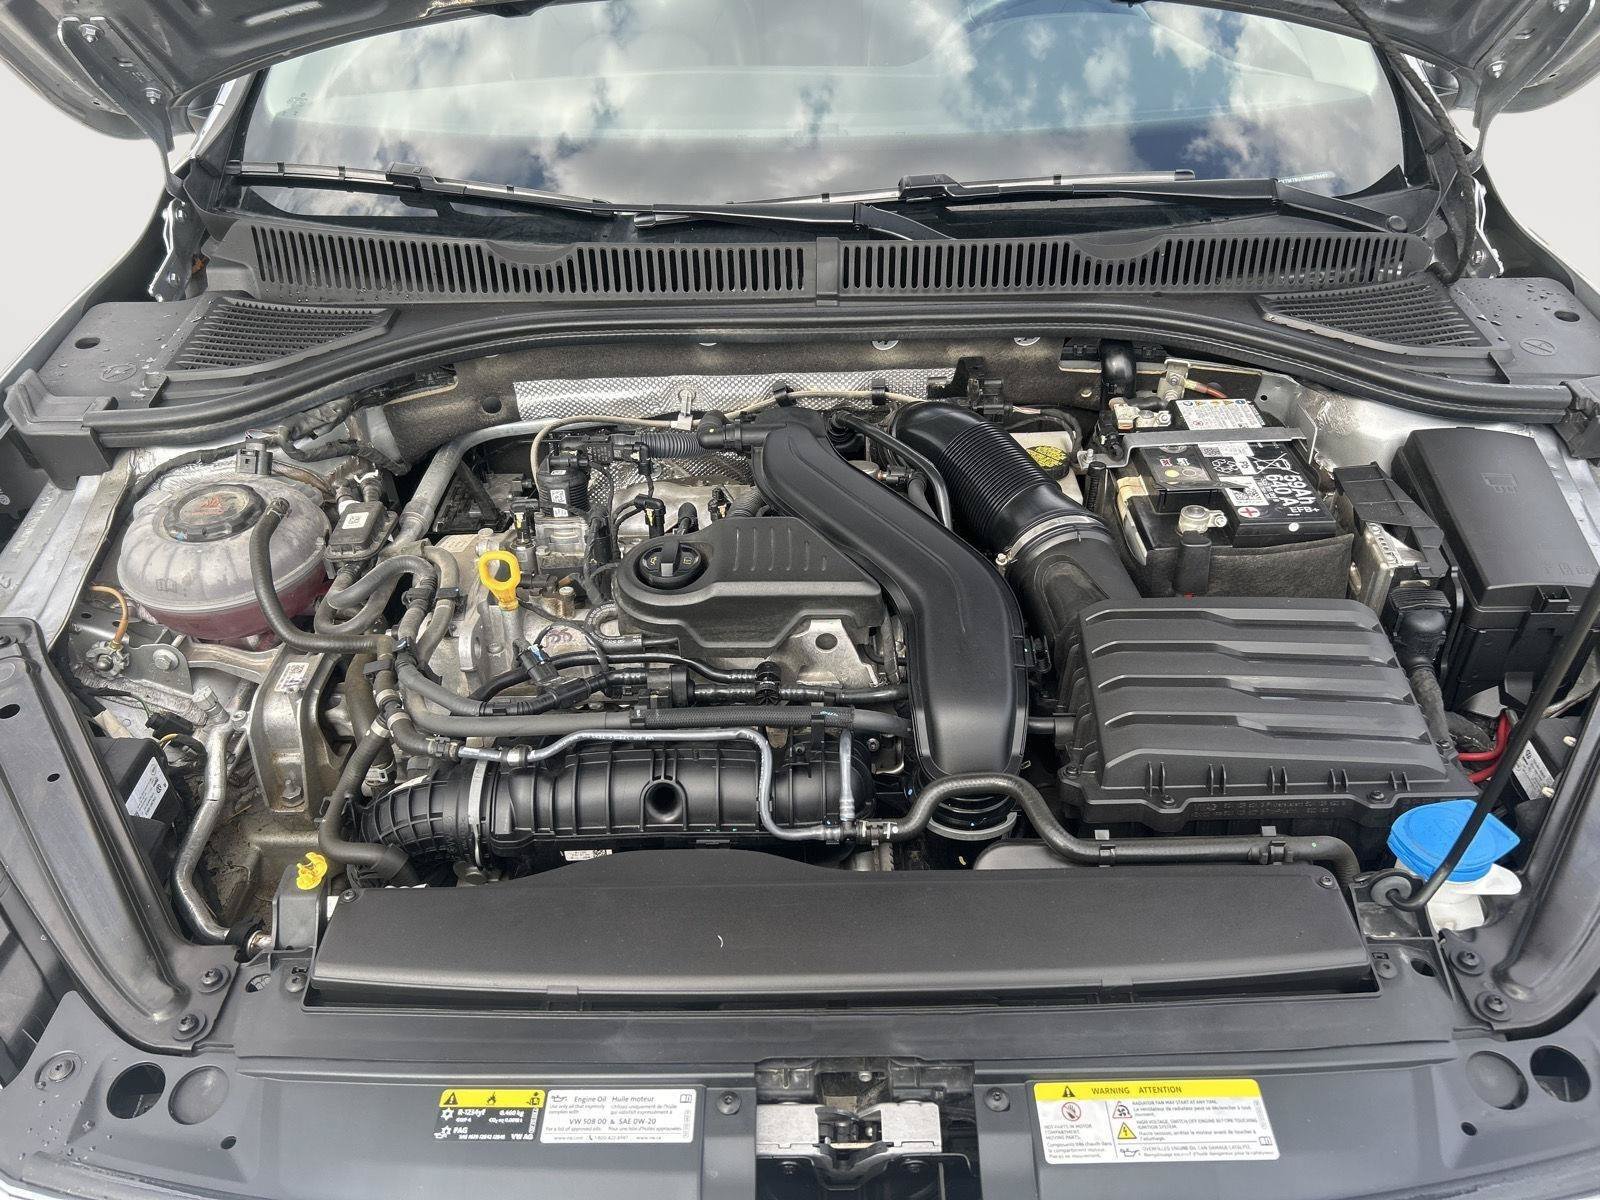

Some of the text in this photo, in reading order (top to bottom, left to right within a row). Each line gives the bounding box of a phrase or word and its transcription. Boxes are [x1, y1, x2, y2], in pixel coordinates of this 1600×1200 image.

[1266, 474, 1292, 495] 640
[1283, 474, 1317, 505] 59Ah
[1288, 506, 1320, 514] EFB+
[1092, 1086, 1182, 1095] WARNING ATTENTION
[574, 1096, 596, 1104] Engine
